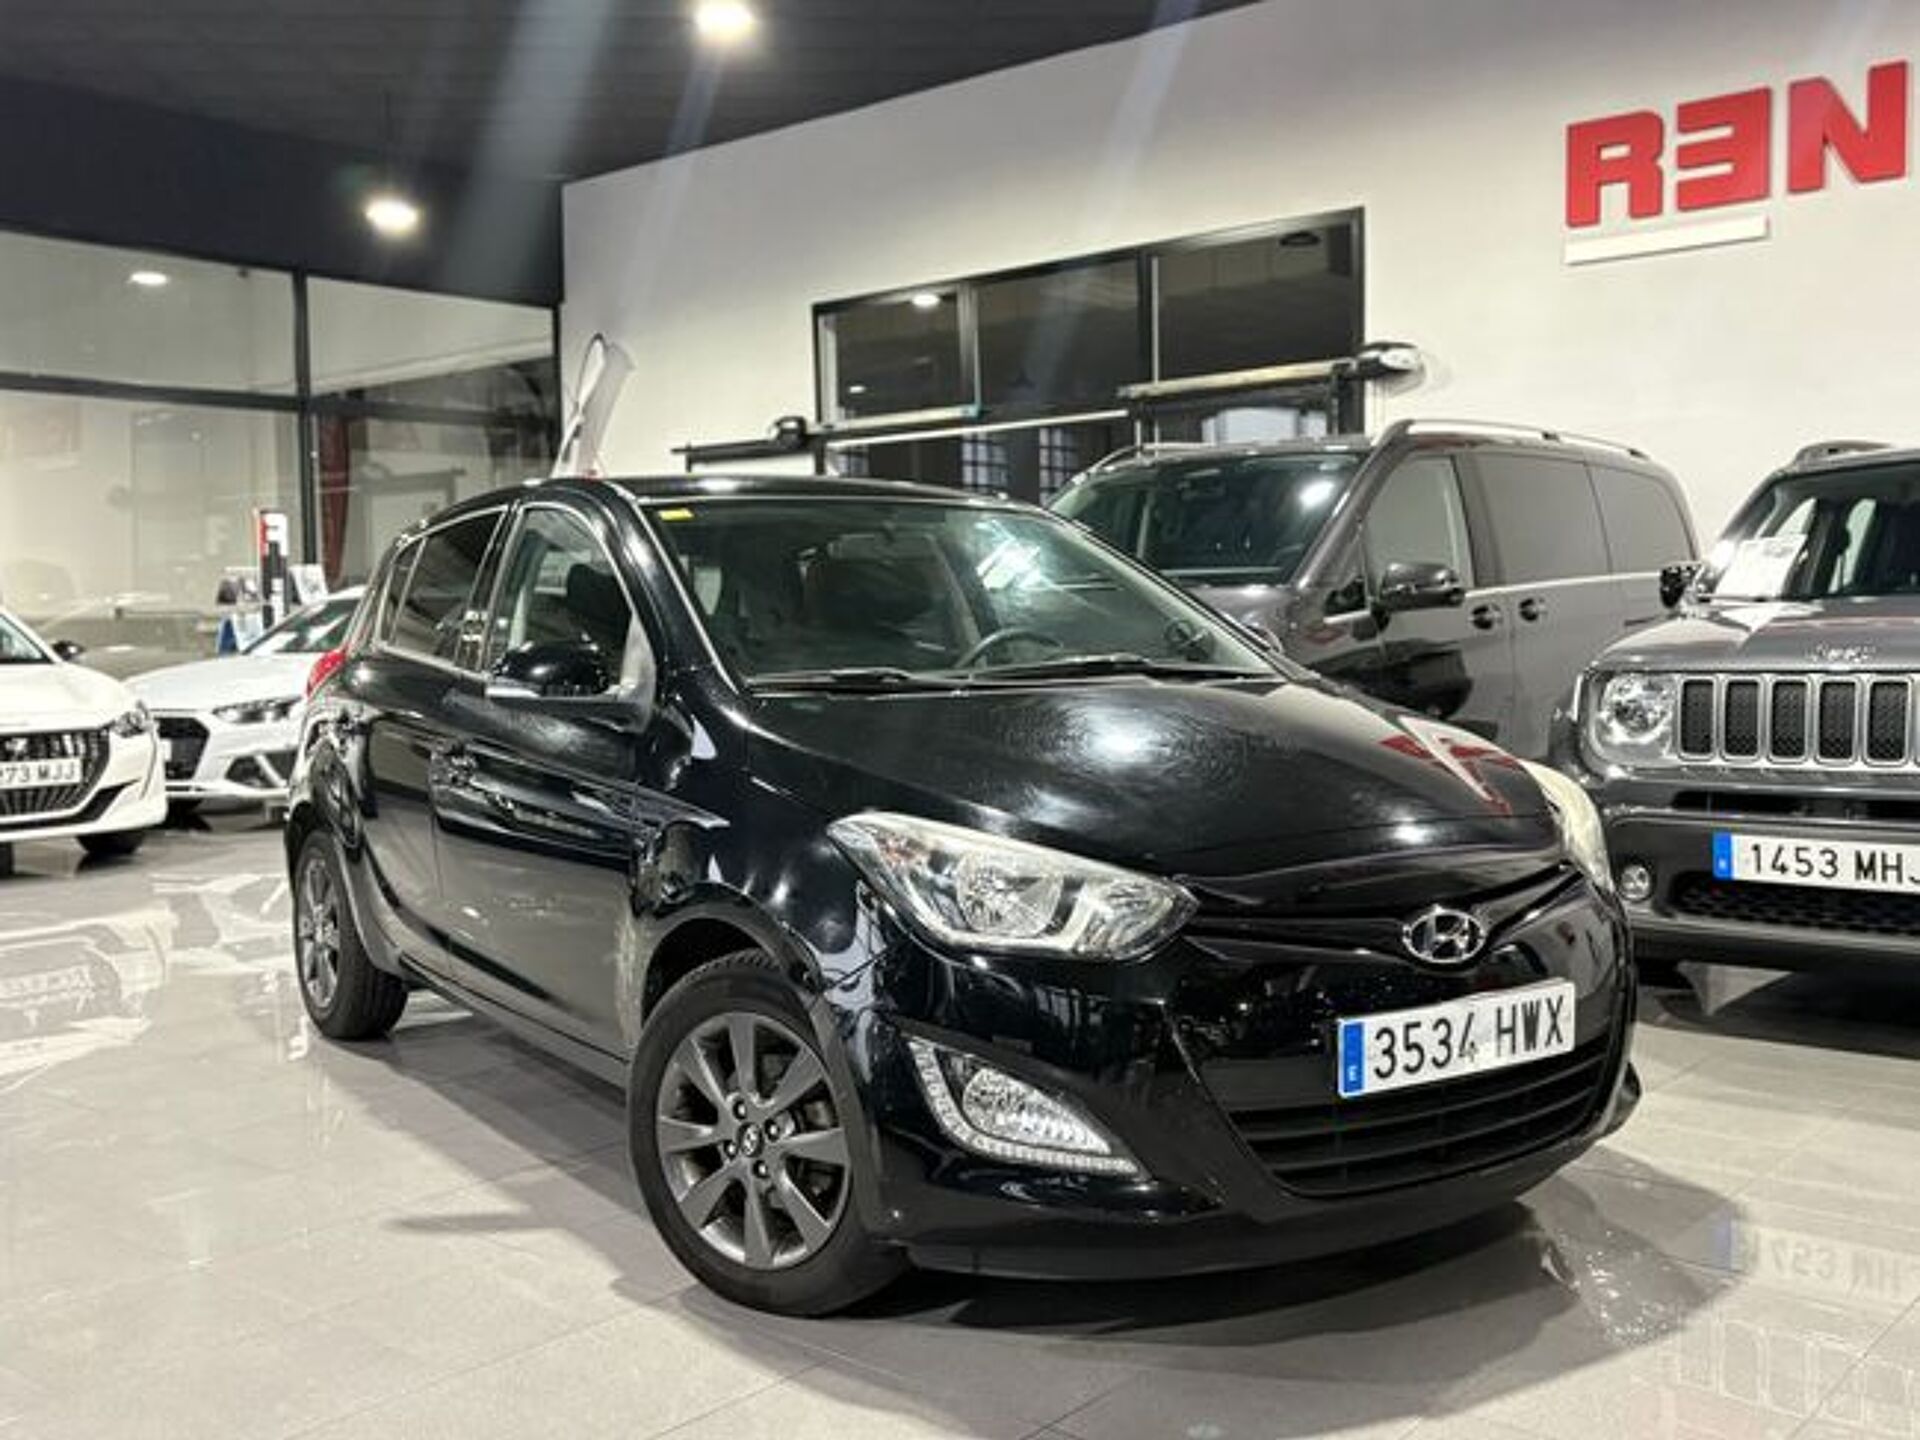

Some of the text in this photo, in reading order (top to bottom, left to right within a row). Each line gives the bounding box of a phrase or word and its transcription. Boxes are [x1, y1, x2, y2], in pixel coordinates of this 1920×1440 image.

[1752, 844, 1839, 879] 1453
[1373, 1012, 1479, 1079] 3534
[1496, 995, 1563, 1055] HWX
